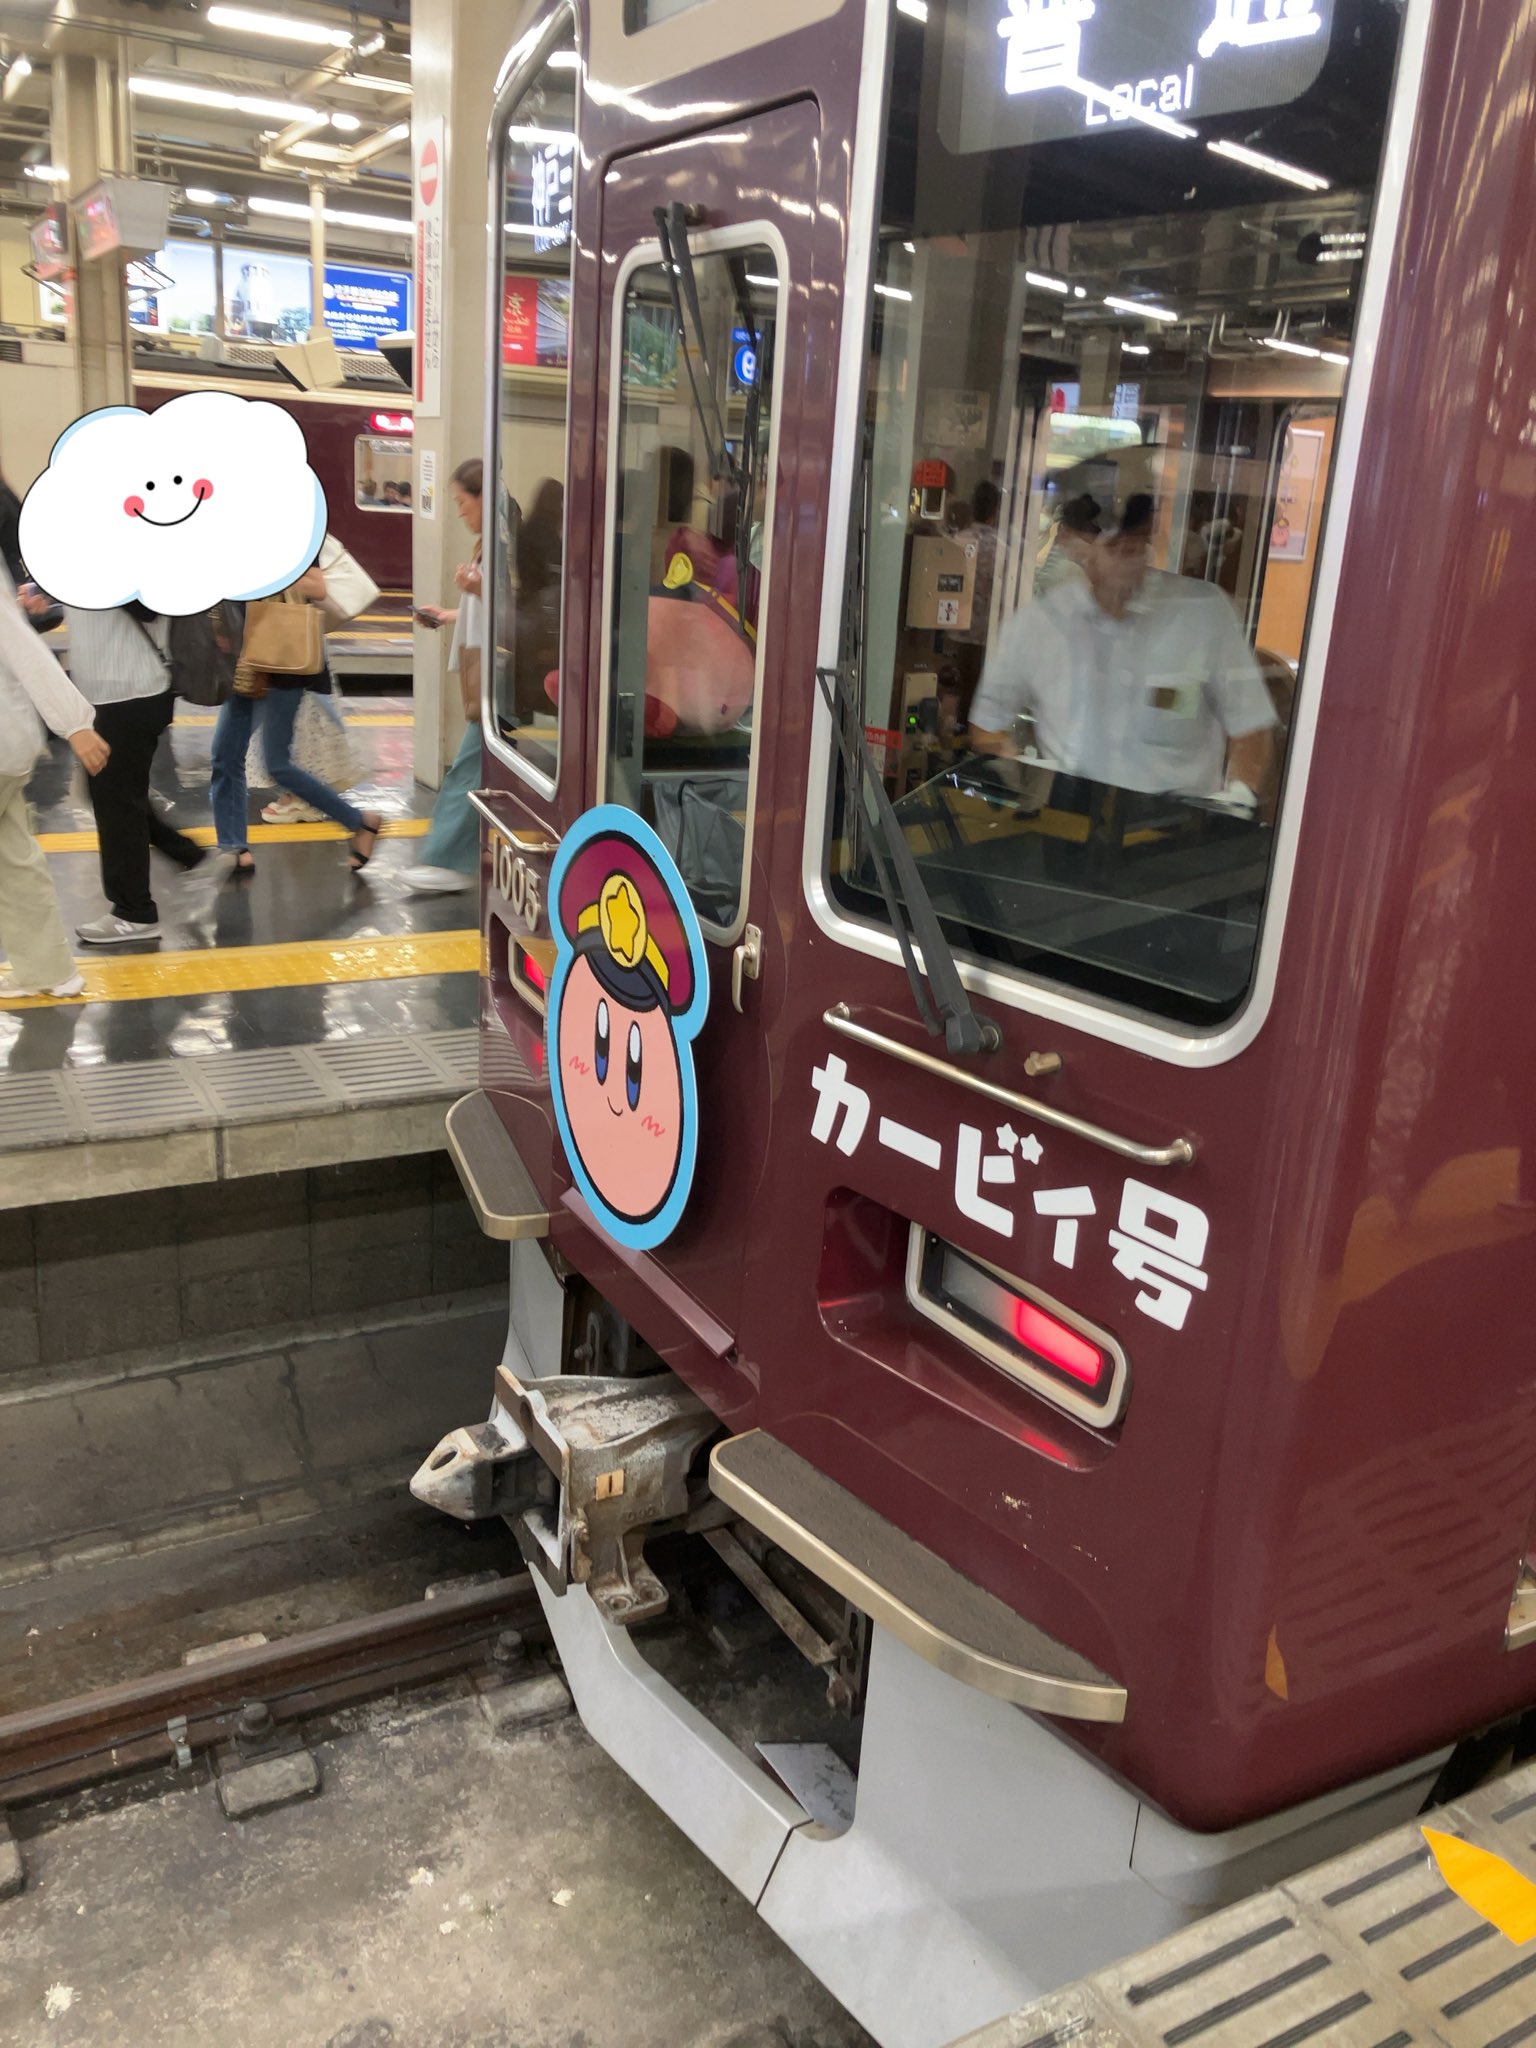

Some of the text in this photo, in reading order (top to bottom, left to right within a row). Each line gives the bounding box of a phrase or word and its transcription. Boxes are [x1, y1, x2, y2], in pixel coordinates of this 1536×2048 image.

[1085, 64, 1195, 126] Local
[492, 834, 542, 932] 1005
[810, 1052, 1209, 1331] カービィ号
